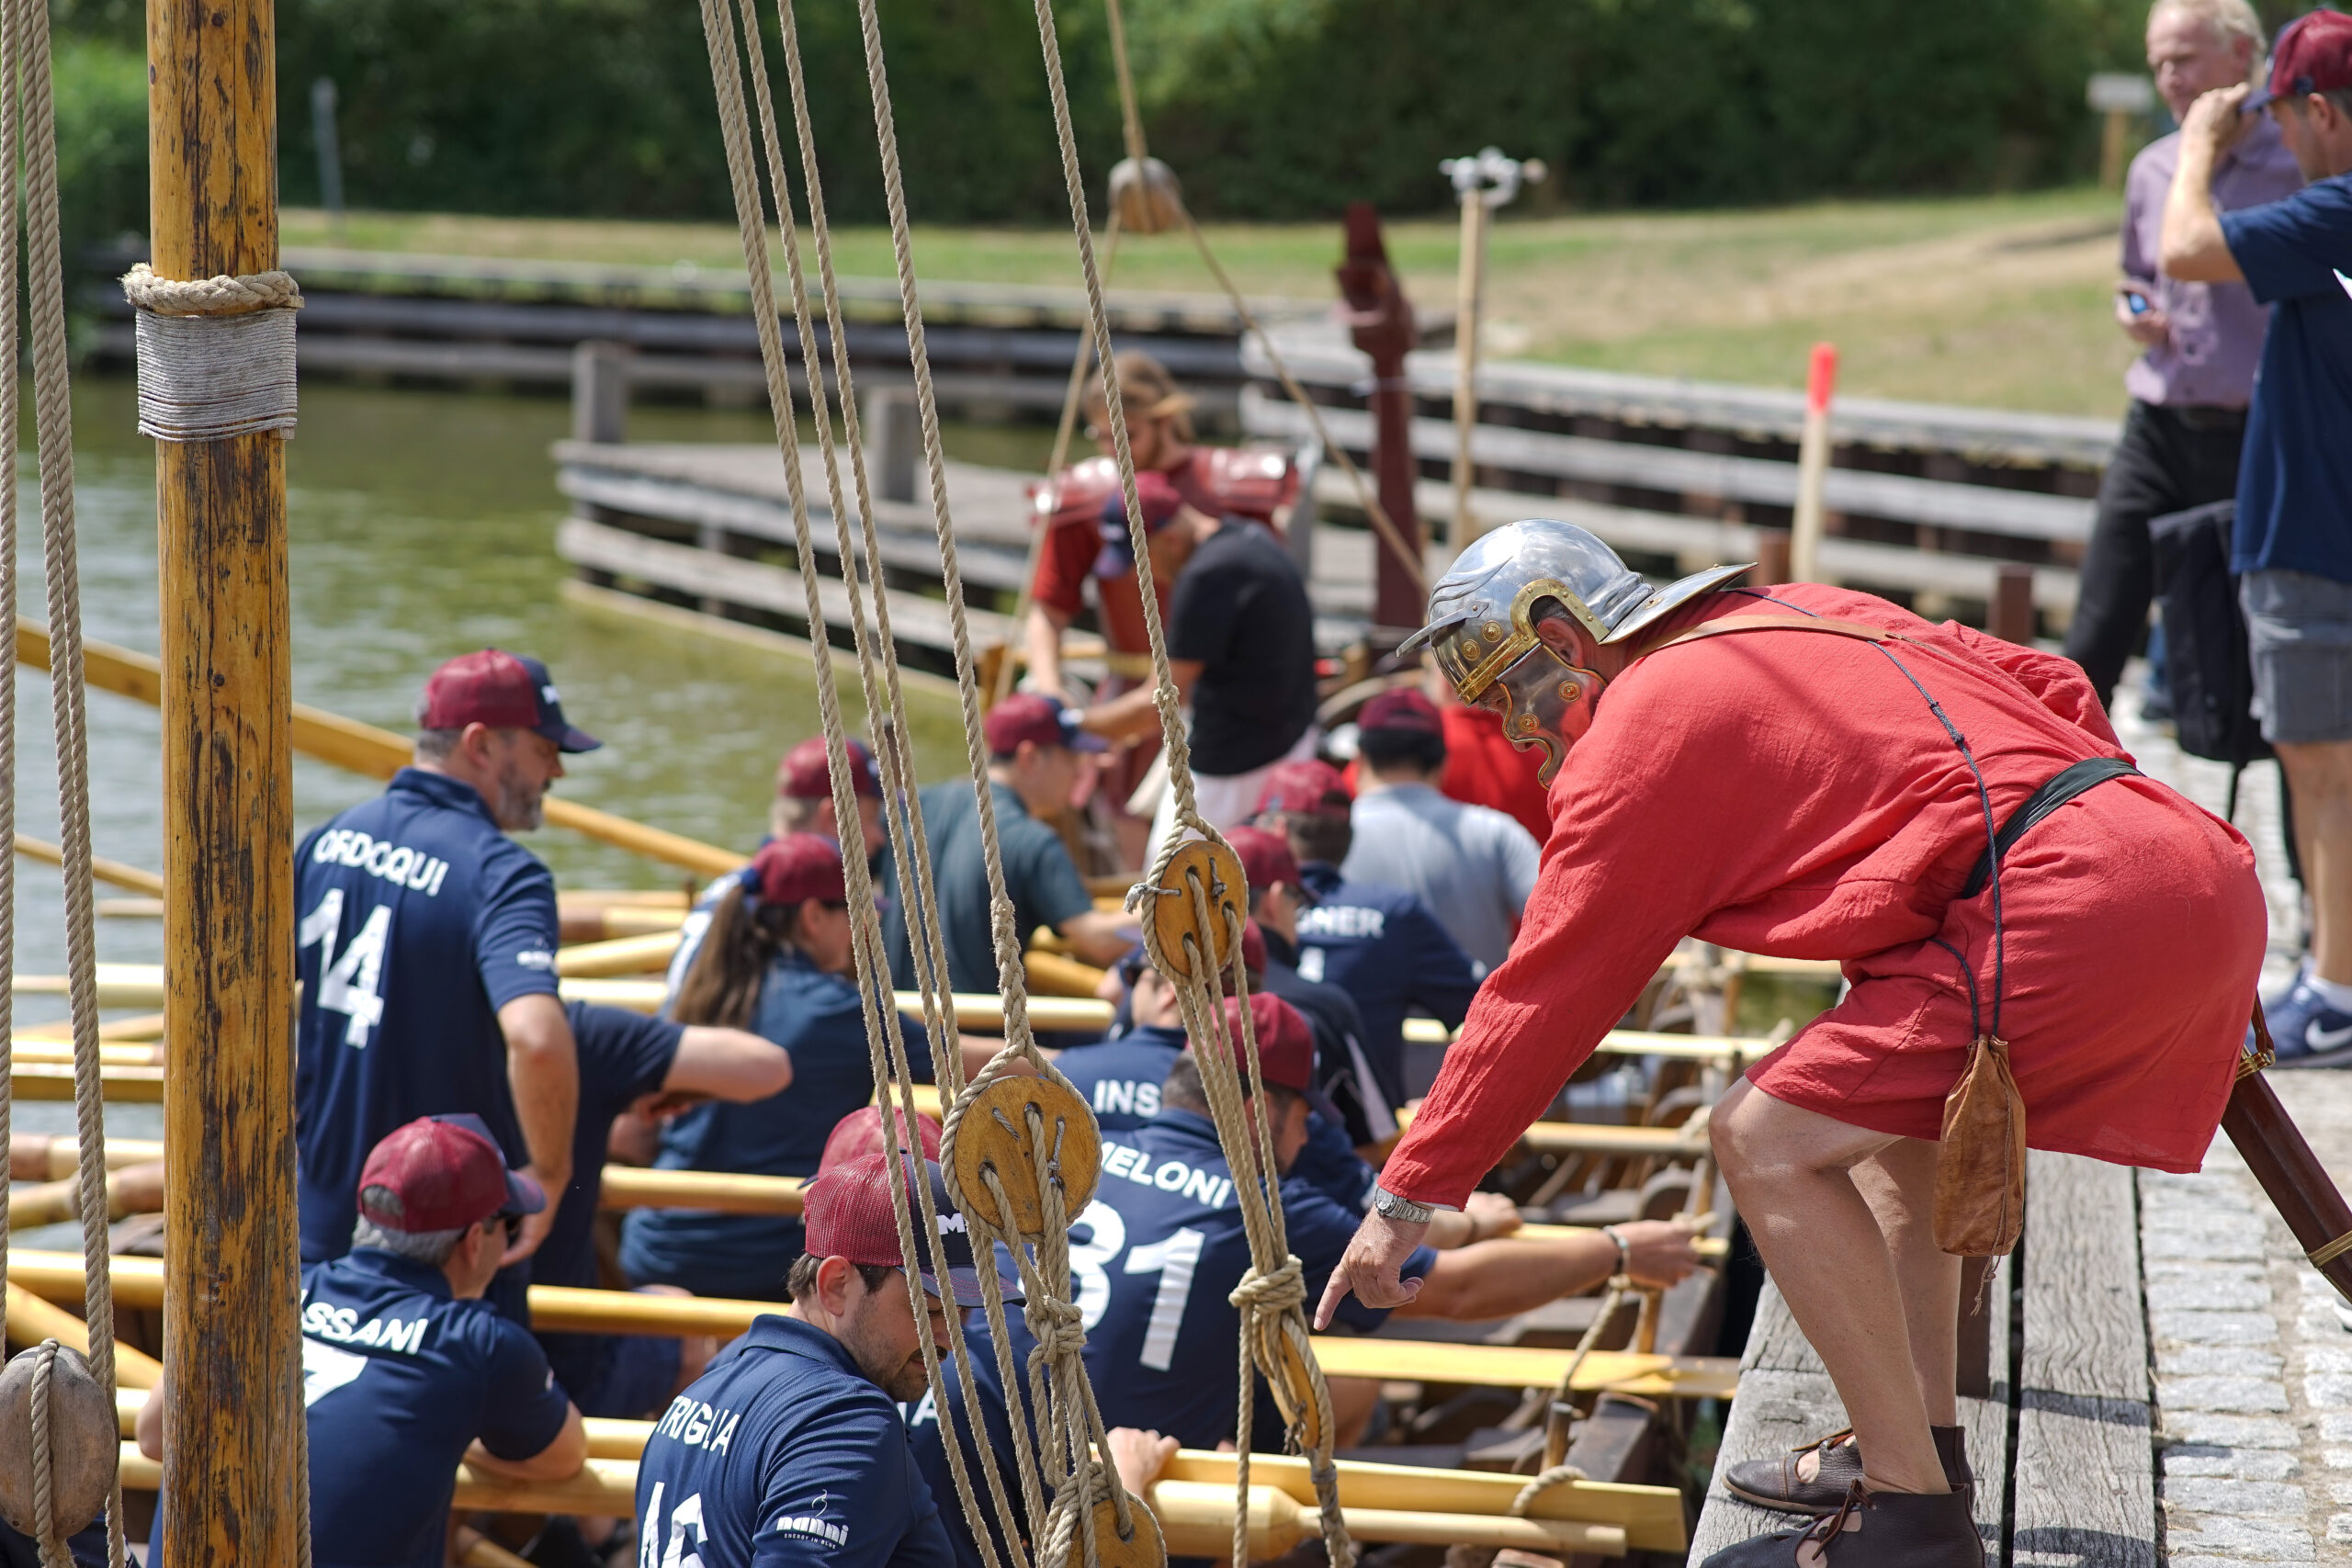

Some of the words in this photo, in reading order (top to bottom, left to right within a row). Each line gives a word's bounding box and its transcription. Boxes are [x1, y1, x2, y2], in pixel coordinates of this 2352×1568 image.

[299, 887, 392, 1049] 14
[300, 1288, 429, 1355] SSANI
[784, 1532, 809, 1540] ENERGY
